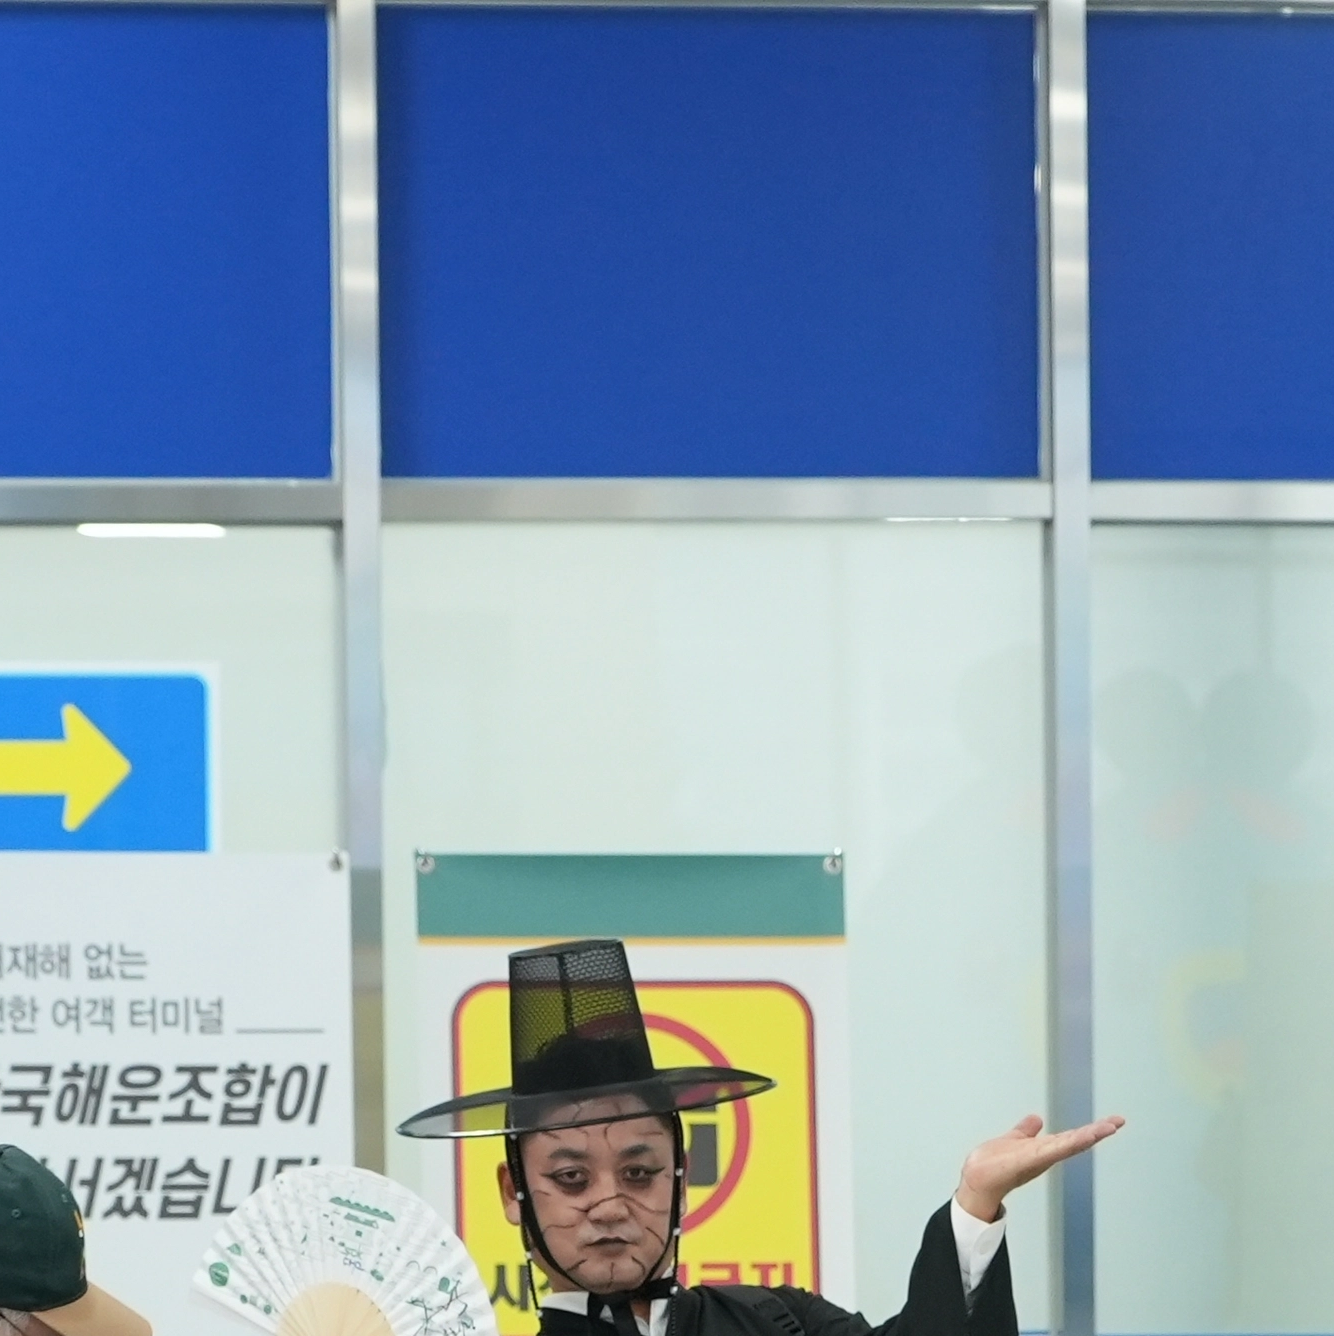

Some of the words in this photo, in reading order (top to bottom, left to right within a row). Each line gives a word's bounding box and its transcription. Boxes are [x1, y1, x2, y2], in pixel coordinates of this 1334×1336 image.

[83, 942, 149, 981] 없는
[51, 996, 116, 1035] 여객
[128, 996, 225, 1035] 터미널
